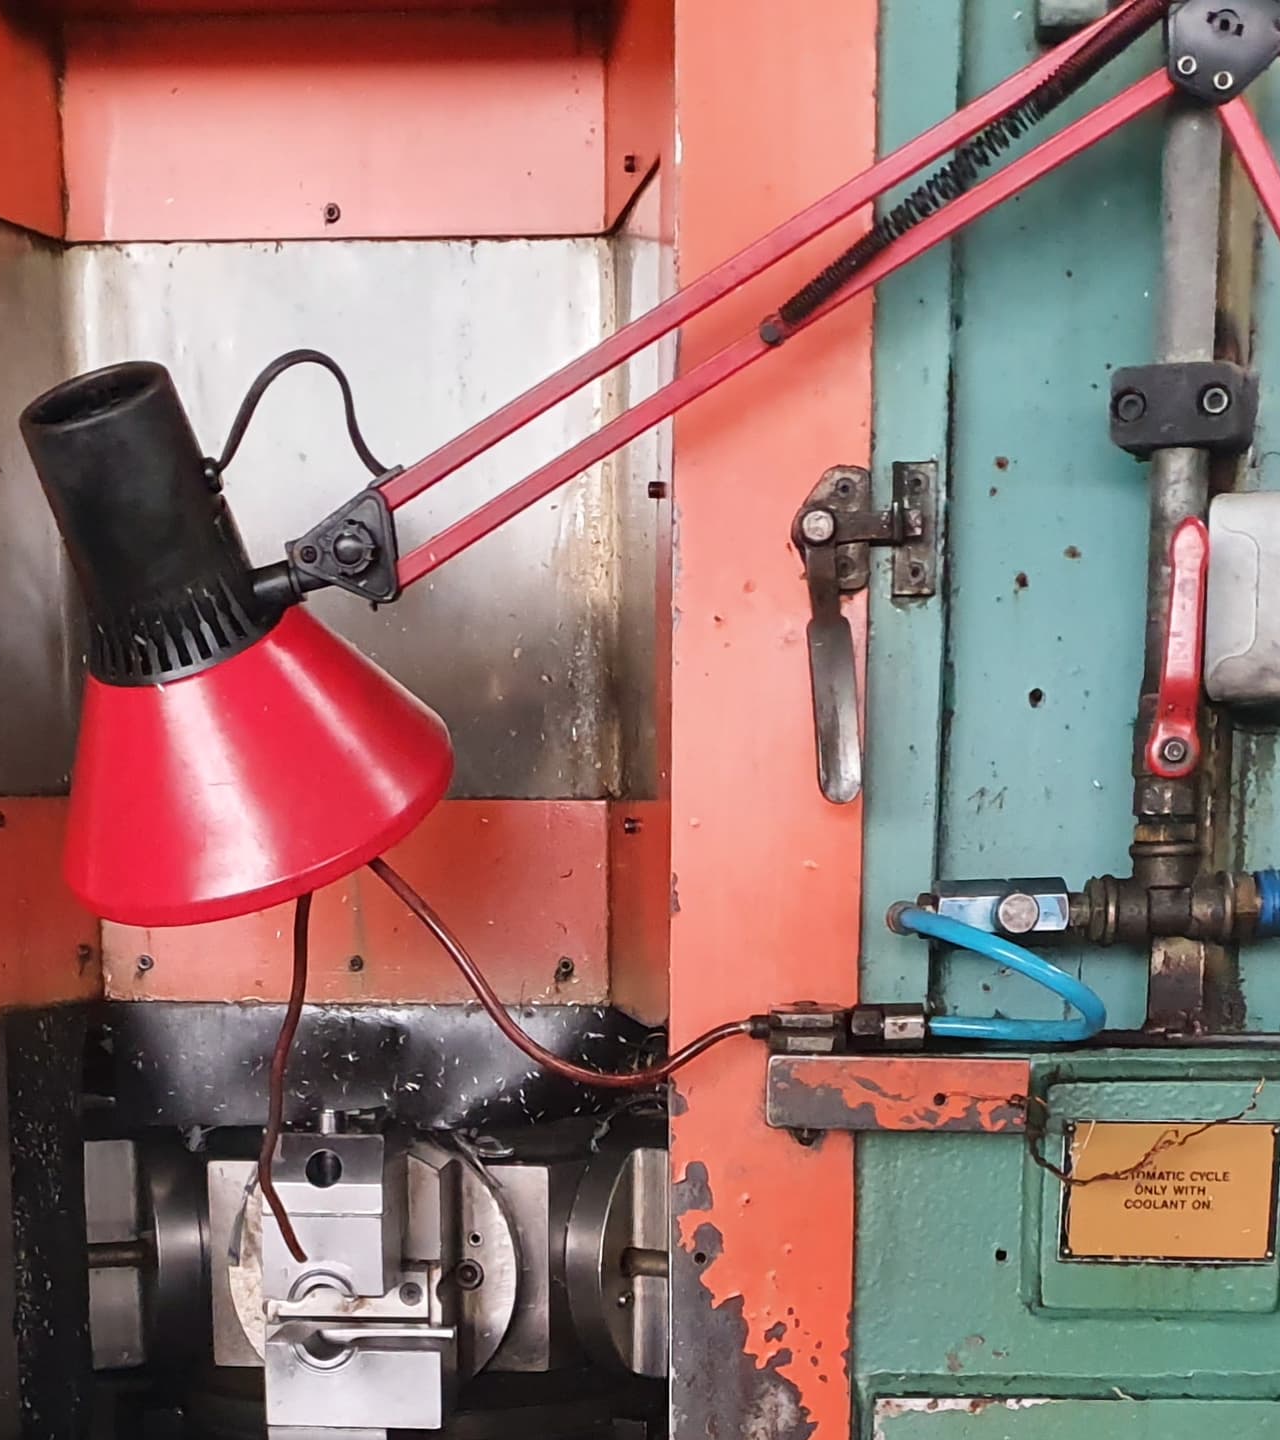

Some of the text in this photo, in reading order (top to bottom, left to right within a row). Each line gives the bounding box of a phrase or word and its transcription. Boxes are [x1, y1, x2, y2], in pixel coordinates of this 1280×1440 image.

[1190, 1171, 1230, 1182] CYCLE
[1134, 1184, 1206, 1196] ONLY WITH
[1124, 1199, 1187, 1210] COOLANT
